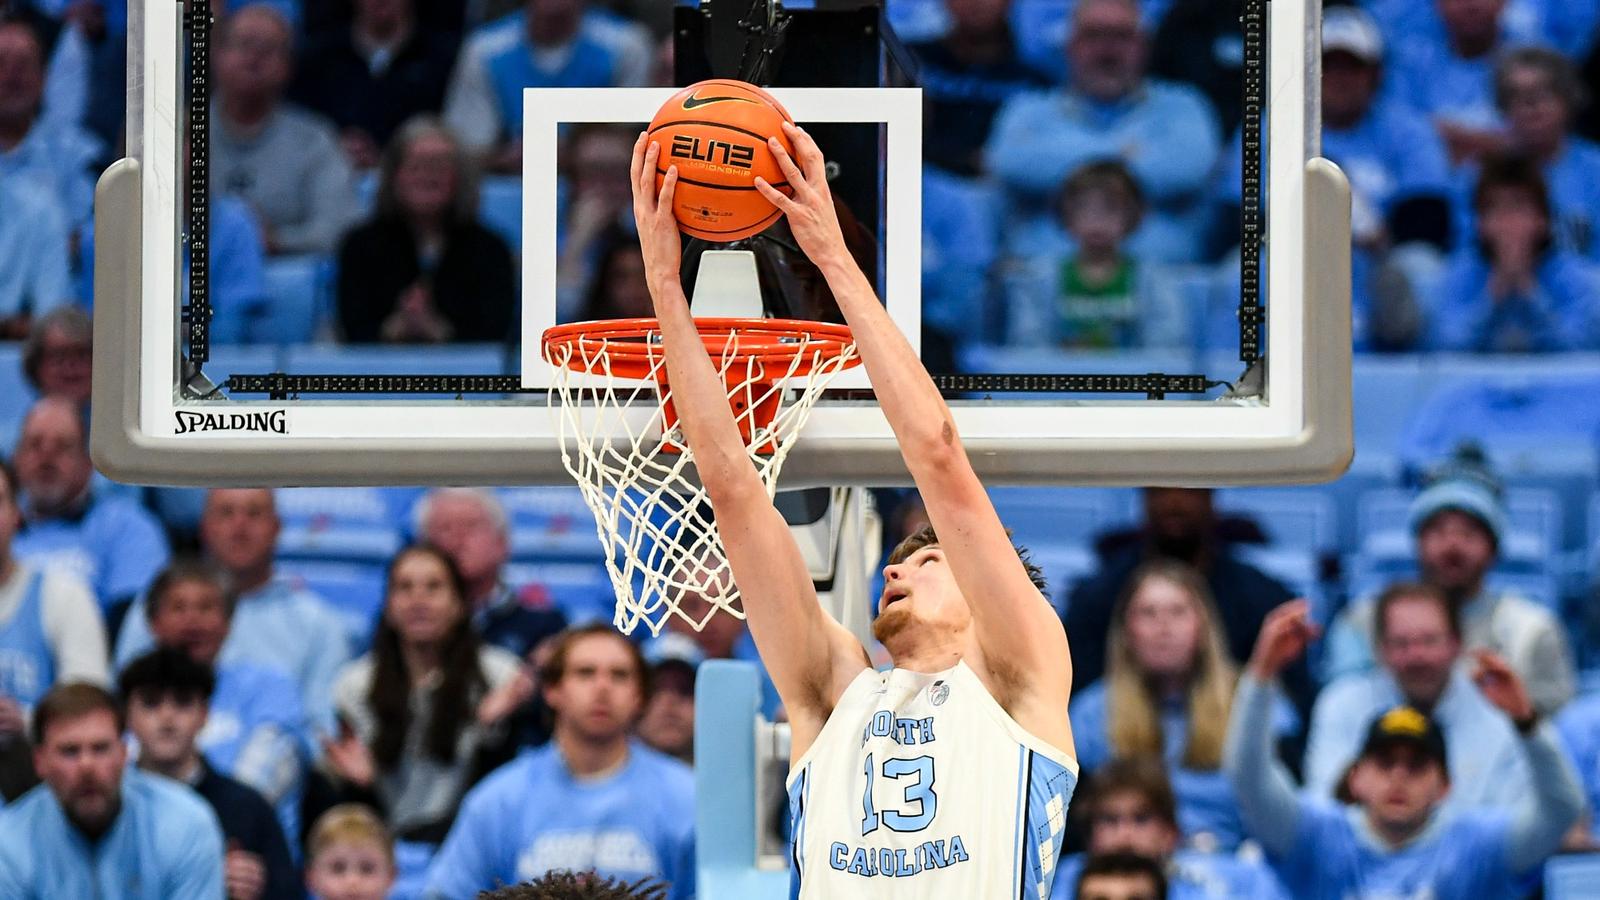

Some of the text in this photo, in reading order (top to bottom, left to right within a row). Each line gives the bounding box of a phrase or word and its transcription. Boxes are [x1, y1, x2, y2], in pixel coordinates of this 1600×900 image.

[670, 157, 751, 177] MPIONSHIP
[671, 135, 754, 168] ELITE
[175, 410, 286, 435] SPALDING
[861, 752, 938, 837] 13
[829, 835, 969, 878] CAROLINA
